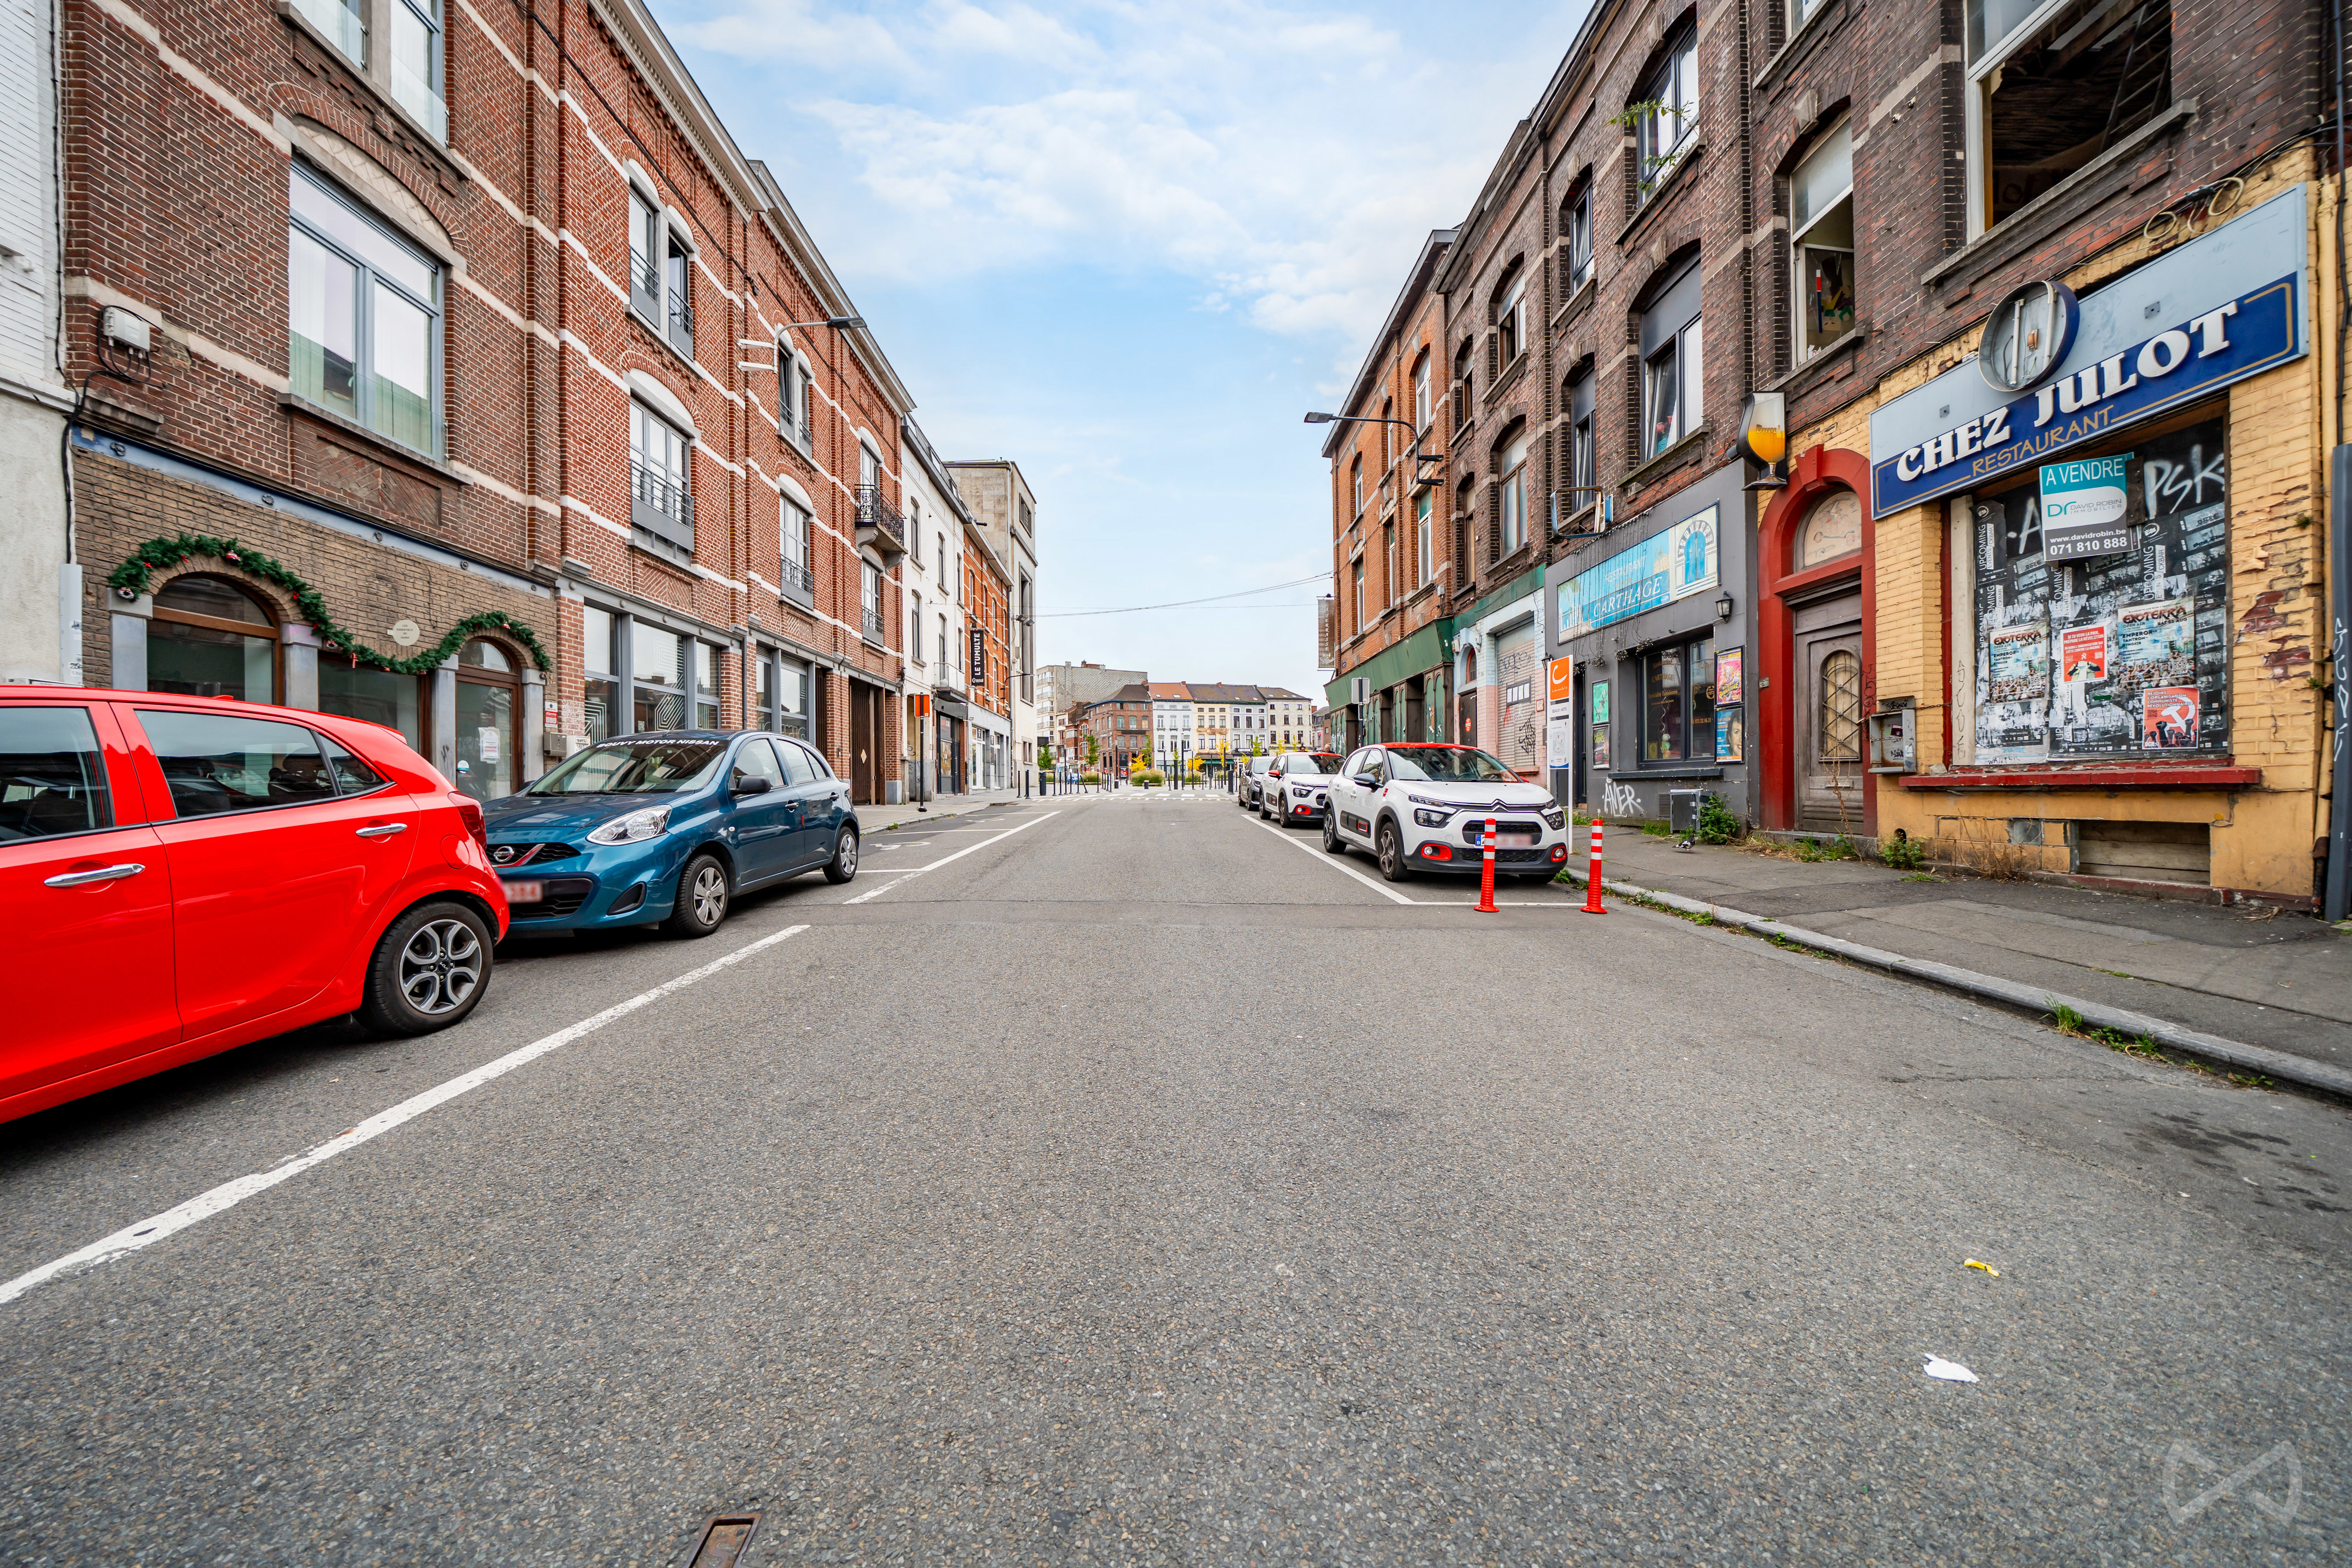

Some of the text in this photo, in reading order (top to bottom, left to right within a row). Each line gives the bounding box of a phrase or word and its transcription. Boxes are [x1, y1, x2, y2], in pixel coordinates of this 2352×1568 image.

[1897, 301, 2238, 482] CHEZ JULOT
[1756, 424, 1781, 434] Duvel
[1973, 405, 2113, 476] RESTAURANT
[2046, 459, 2124, 486] A VENDRE
[2070, 504, 2122, 514] IMMOBILIER
[2050, 529, 2126, 543] www.davidrobin.be
[1978, 524, 1987, 570] UPCOMING
[2050, 543, 2072, 555] 071
[2076, 540, 2100, 552] 810
[2103, 537, 2127, 549] 888
[1605, 556, 1646, 583] RESTAURANT
[2143, 546, 2154, 600] UPCOMING
[1594, 577, 1662, 617] CARTHAGE
[2123, 606, 2187, 624] EXOTERRA
[2122, 630, 2153, 638] EMPEROR
[974, 667, 981, 675] LE
[1653, 659, 1673, 669] Restaurant
[1652, 672, 1674, 683] CARTHAGE
